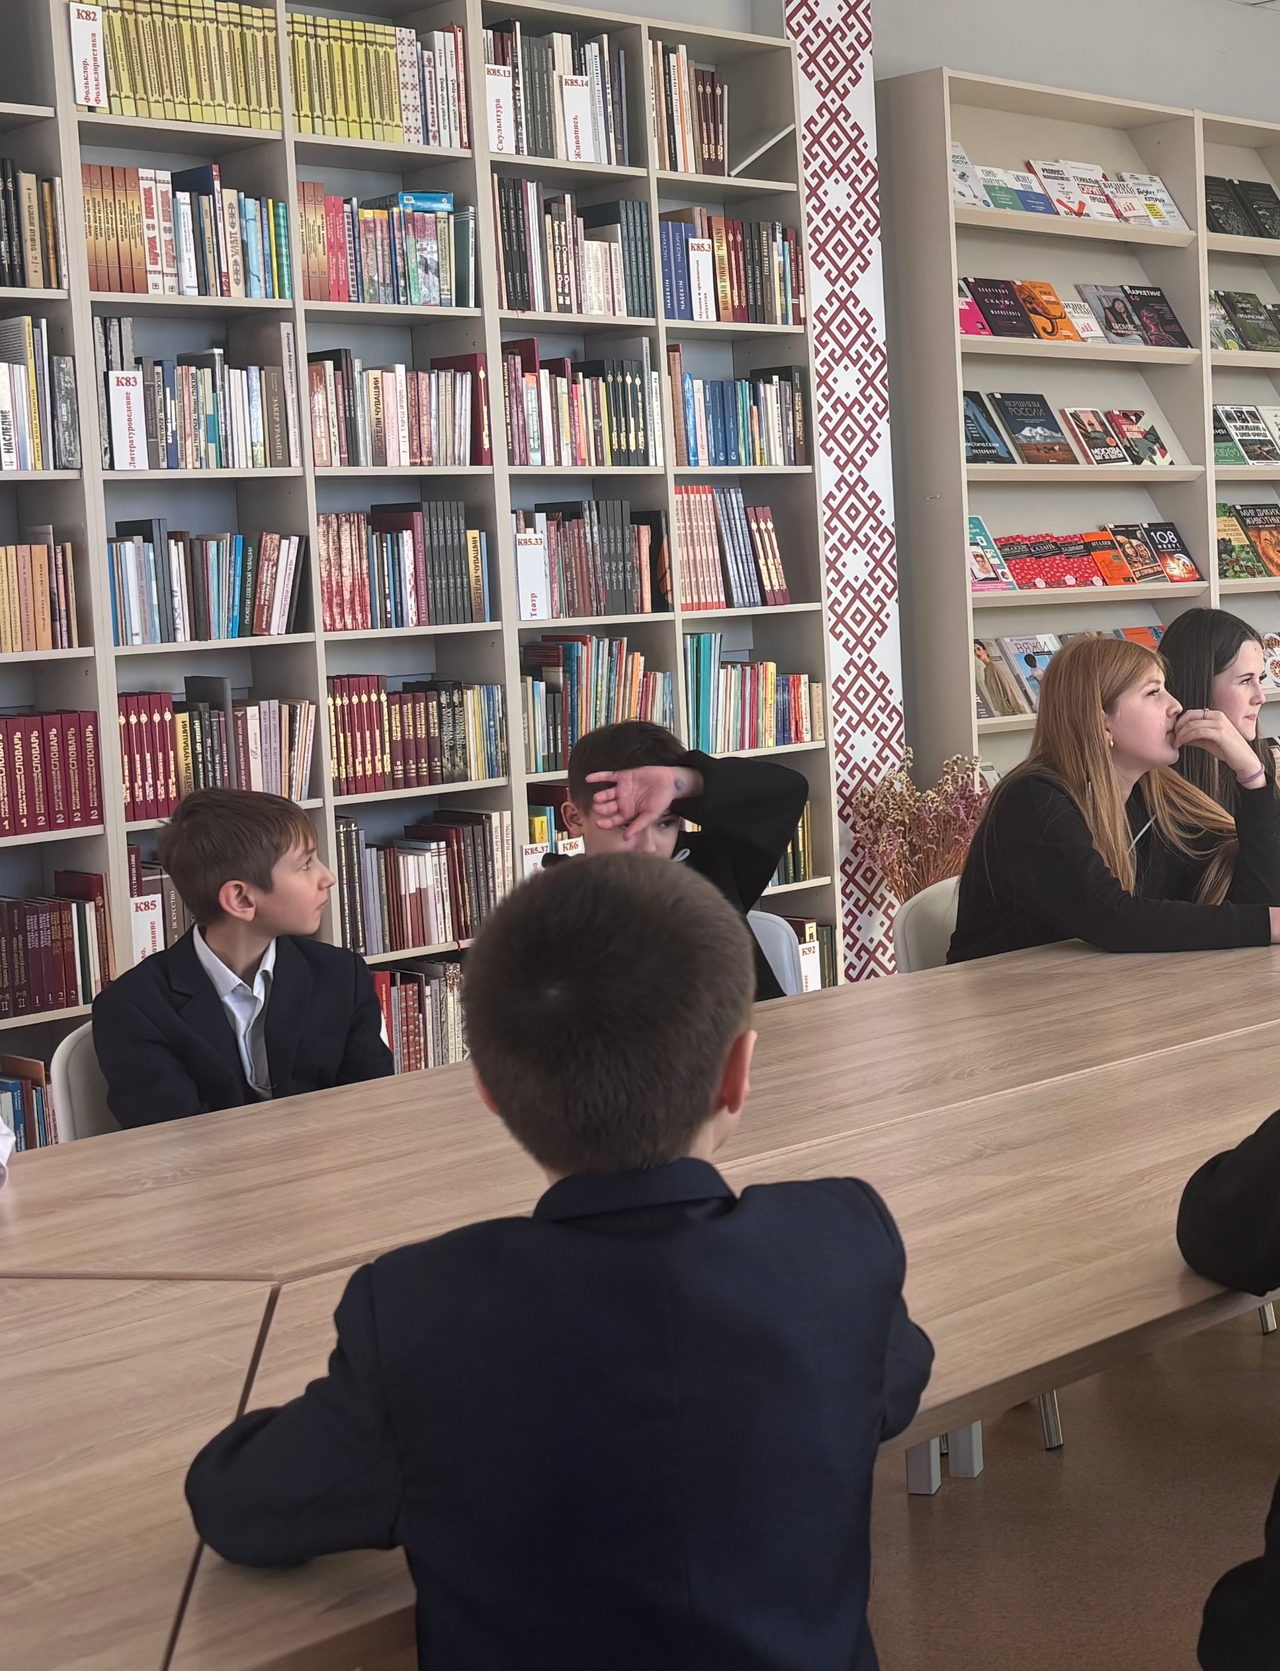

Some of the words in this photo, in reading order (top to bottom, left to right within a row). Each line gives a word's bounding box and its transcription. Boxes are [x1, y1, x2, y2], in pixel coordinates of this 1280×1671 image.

[76, 9, 97, 21] К82
[91, 33, 100, 104] Фольклористика
[487, 68, 510, 77] К85.13
[565, 79, 588, 87] К85.14
[495, 98, 504, 151] Скульптура
[573, 115, 582, 159] Живопись
[116, 376, 137, 386] К83
[373, 377, 381, 416] ЧУВАШИИ
[1008, 408, 1045, 416] РОССИИ
[1, 410, 13, 454] НАСЛЕДИЕ
[125, 391, 136, 468] Литературоведение
[374, 418, 384, 458] ПИСАТЕЛИ
[1091, 448, 1119, 456] МОСКВА
[1256, 508, 1280, 516] ДИКИХ
[518, 538, 542, 546] К85.33
[1150, 531, 1178, 544] 108
[472, 537, 481, 574] ЧУВАШИИ
[530, 593, 538, 617] Театр
[1015, 641, 1049, 653] ВЯЖИ
[15, 733, 23, 772] СЛОВАРЬ
[31, 730, 41, 771] СЛОВАРЬ
[50, 728, 60, 770] СЛОВАРЬ
[68, 728, 78, 769] СЛОВАРЬ
[87, 725, 97, 766] СЛОВАРЬ
[181, 721, 190, 761] ЧУВАШИИ
[183, 763, 192, 794] САТЕЛИ
[525, 846, 548, 855] К85.37
[562, 841, 579, 852] К86
[134, 900, 157, 913] К85
[169, 889, 177, 929] ИСКУССТВО
[802, 946, 816, 956] К92
